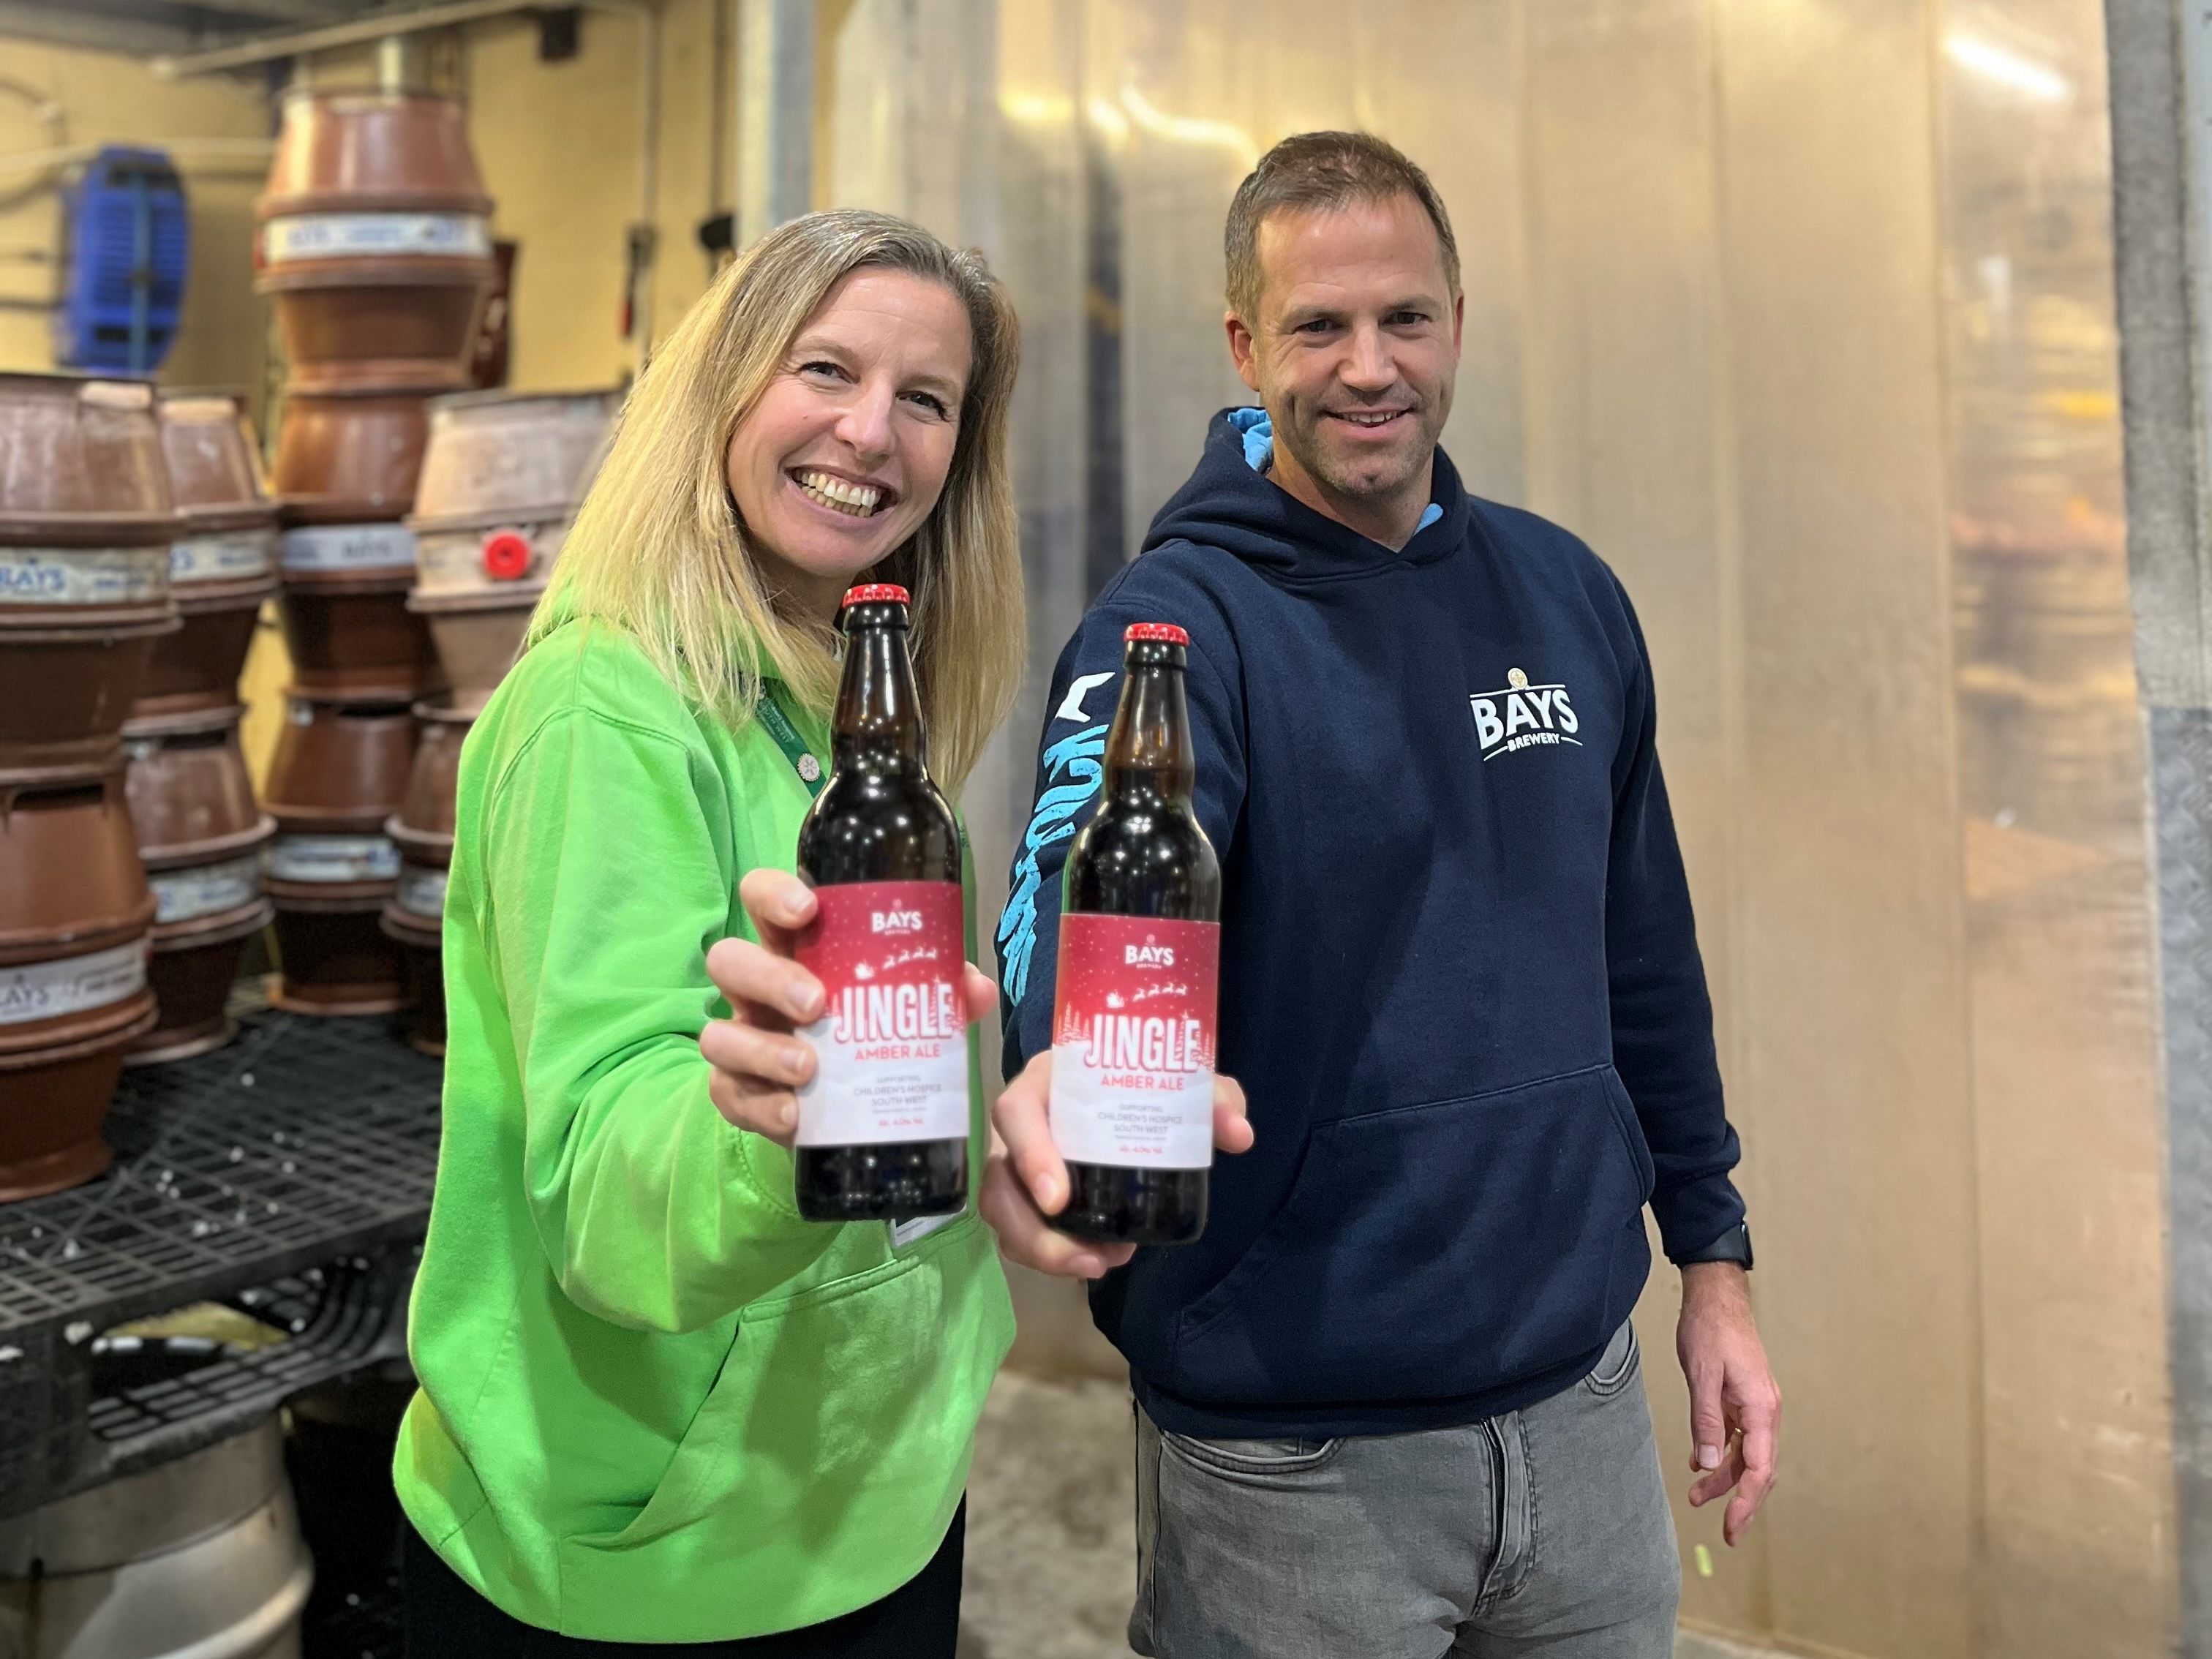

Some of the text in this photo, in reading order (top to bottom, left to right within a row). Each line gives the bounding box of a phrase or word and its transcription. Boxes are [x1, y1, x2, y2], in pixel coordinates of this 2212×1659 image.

[1470, 689, 1579, 750] BAYS
[1507, 732, 1560, 752] BREWERY
[871, 911, 922, 933] BAYS
[1125, 944, 1174, 966] BAYS
[0, 986, 49, 1007] AYS
[835, 983, 953, 1044] JINGLE
[854, 1044, 941, 1061] AMBER ALE
[1084, 1014, 1200, 1073] JINGLE
[907, 1083, 943, 1093] HOSPICE
[1100, 1075, 1184, 1091] AMBER ALE
[871, 1096, 928, 1106] SOUTH WEST
[1096, 1112, 1183, 1124] CHILDREN'S HOSPICE
[1113, 1124, 1168, 1134] SOUTH WEST
